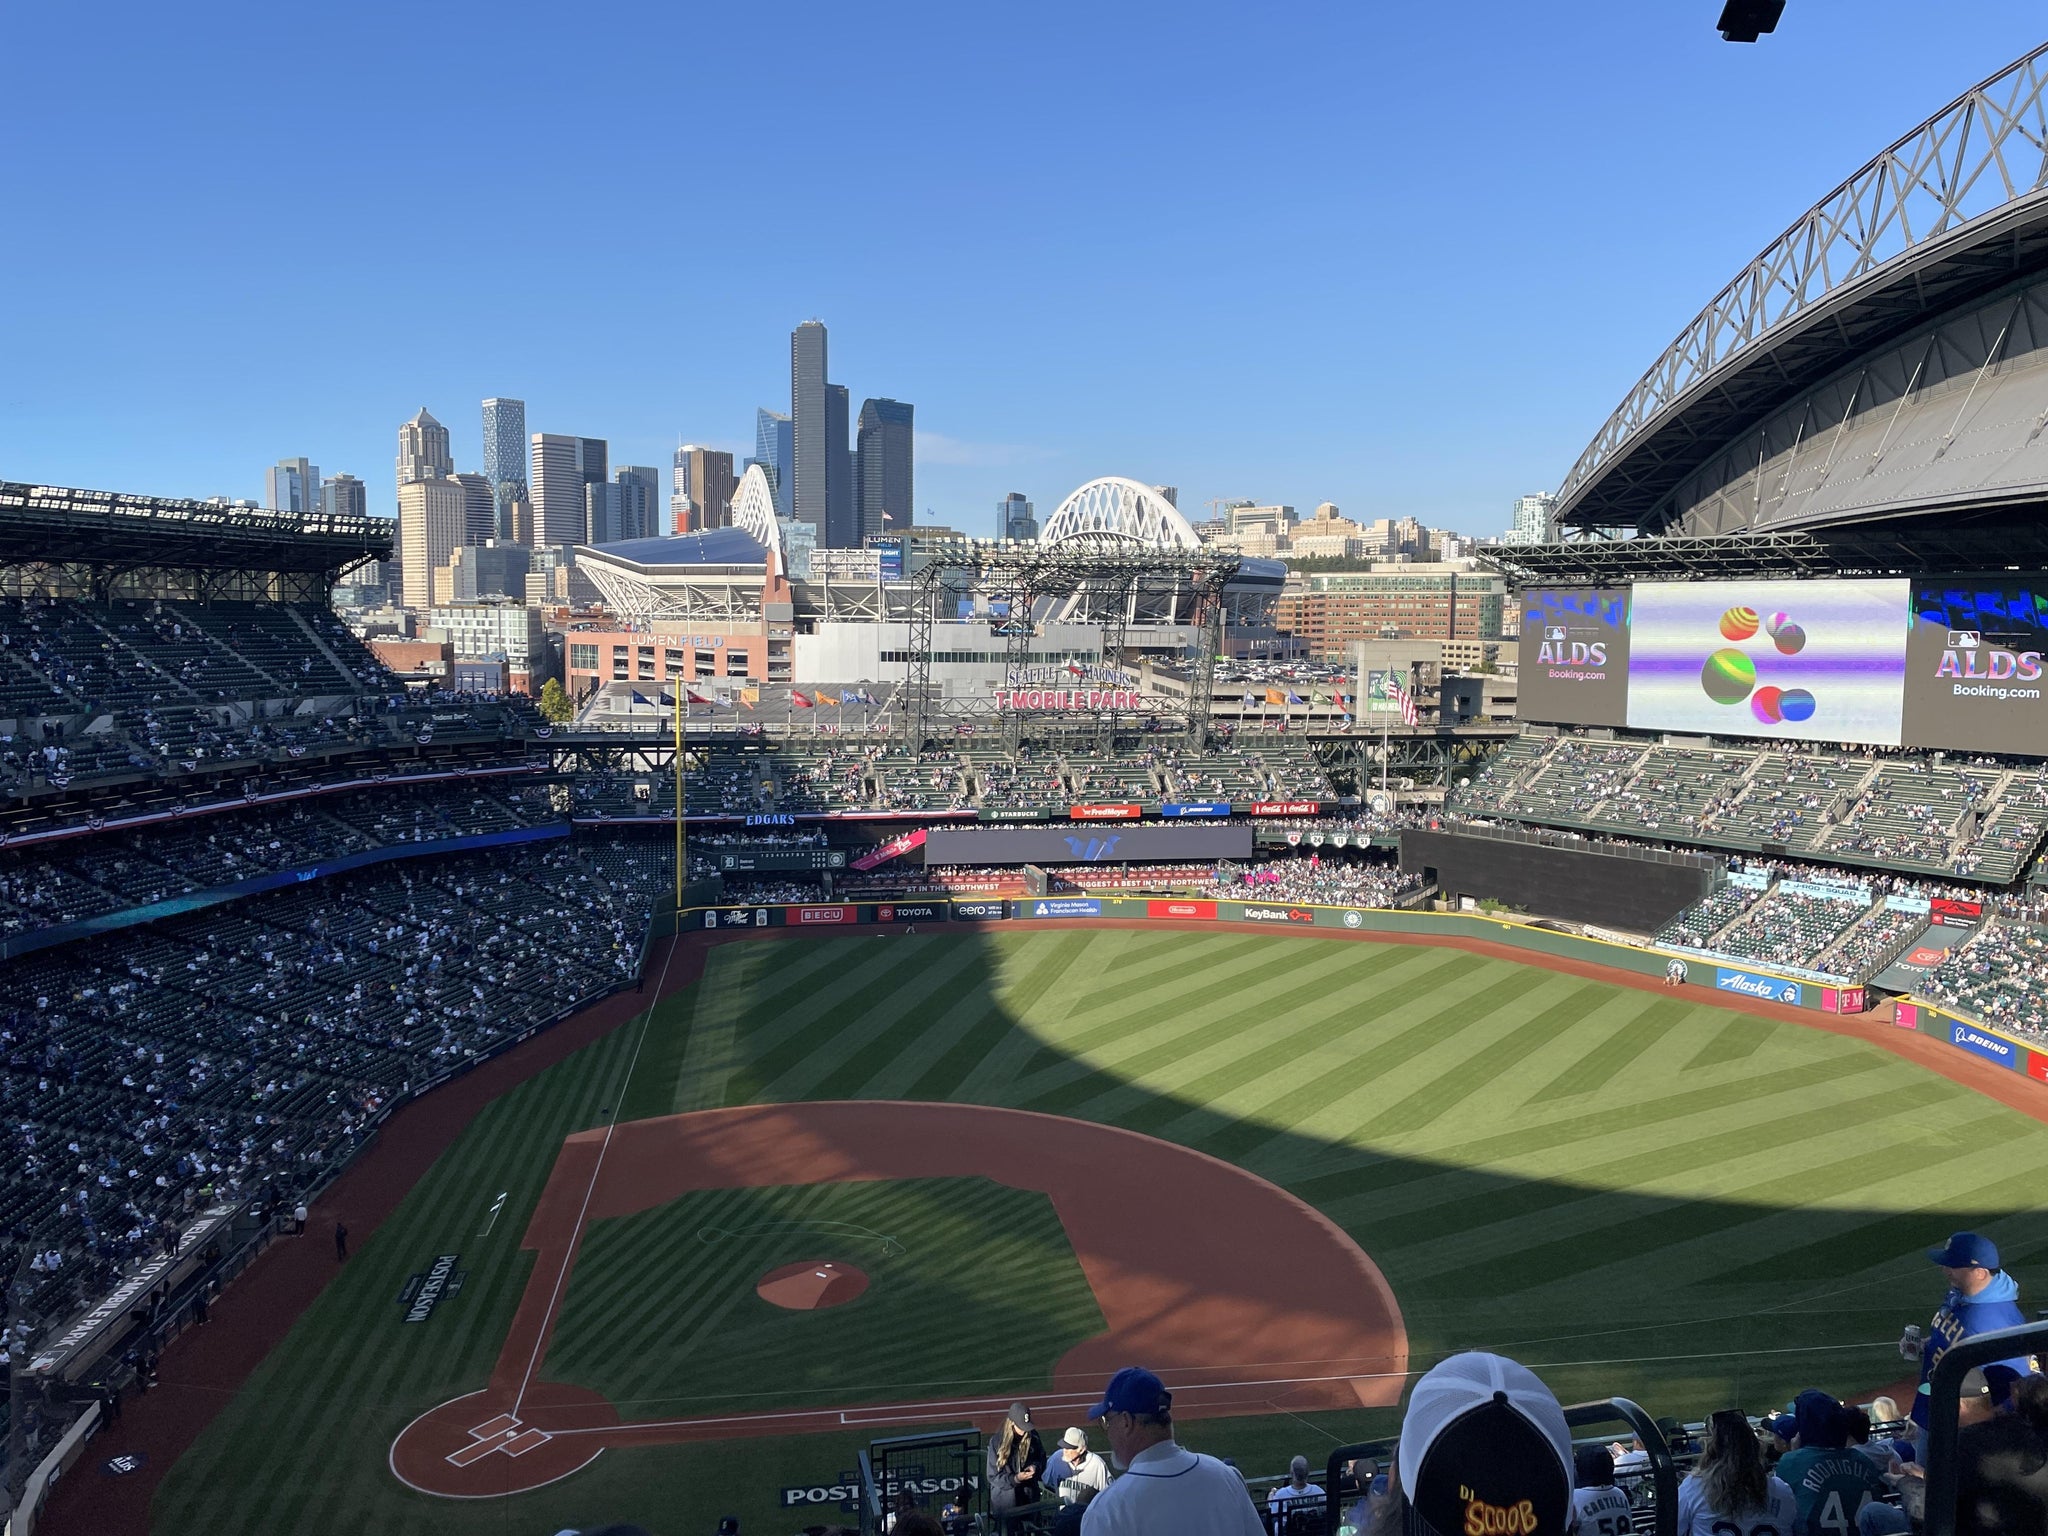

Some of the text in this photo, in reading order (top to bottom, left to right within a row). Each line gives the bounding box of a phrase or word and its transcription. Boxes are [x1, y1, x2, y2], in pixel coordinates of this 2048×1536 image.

[629, 635, 724, 647] LUMEN FIELD
[1251, 639, 1282, 650] LUMEN
[1536, 641, 1607, 666] ALDS
[1934, 650, 2043, 681] ALDS
[1007, 664, 1131, 687] SEATTLE MARINERS
[1548, 669, 1606, 681] Booking.com
[993, 690, 1141, 710] T-MOBILE PARK
[1953, 684, 2040, 700] Booking.com
[948, 883, 1000, 892] NORTHWEST
[1078, 880, 1112, 888] BIGGEST
[1793, 883, 1857, 896] J-ROD SQUAD
[896, 908, 933, 916] TOYOTA
[959, 905, 985, 916] eero
[1245, 908, 1289, 920] KeyBank
[1720, 974, 1773, 996] Alaska
[1967, 1034, 2009, 1056] BOEING
[140, 1261, 169, 1275] TO
[87, 1274, 154, 1319] T-MOBILE
[406, 1255, 458, 1322] POSTSEASON
[54, 1319, 103, 1347] PARK
[111, 1456, 136, 1472] ALDS
[1465, 1500, 1538, 1536] SCOOB
